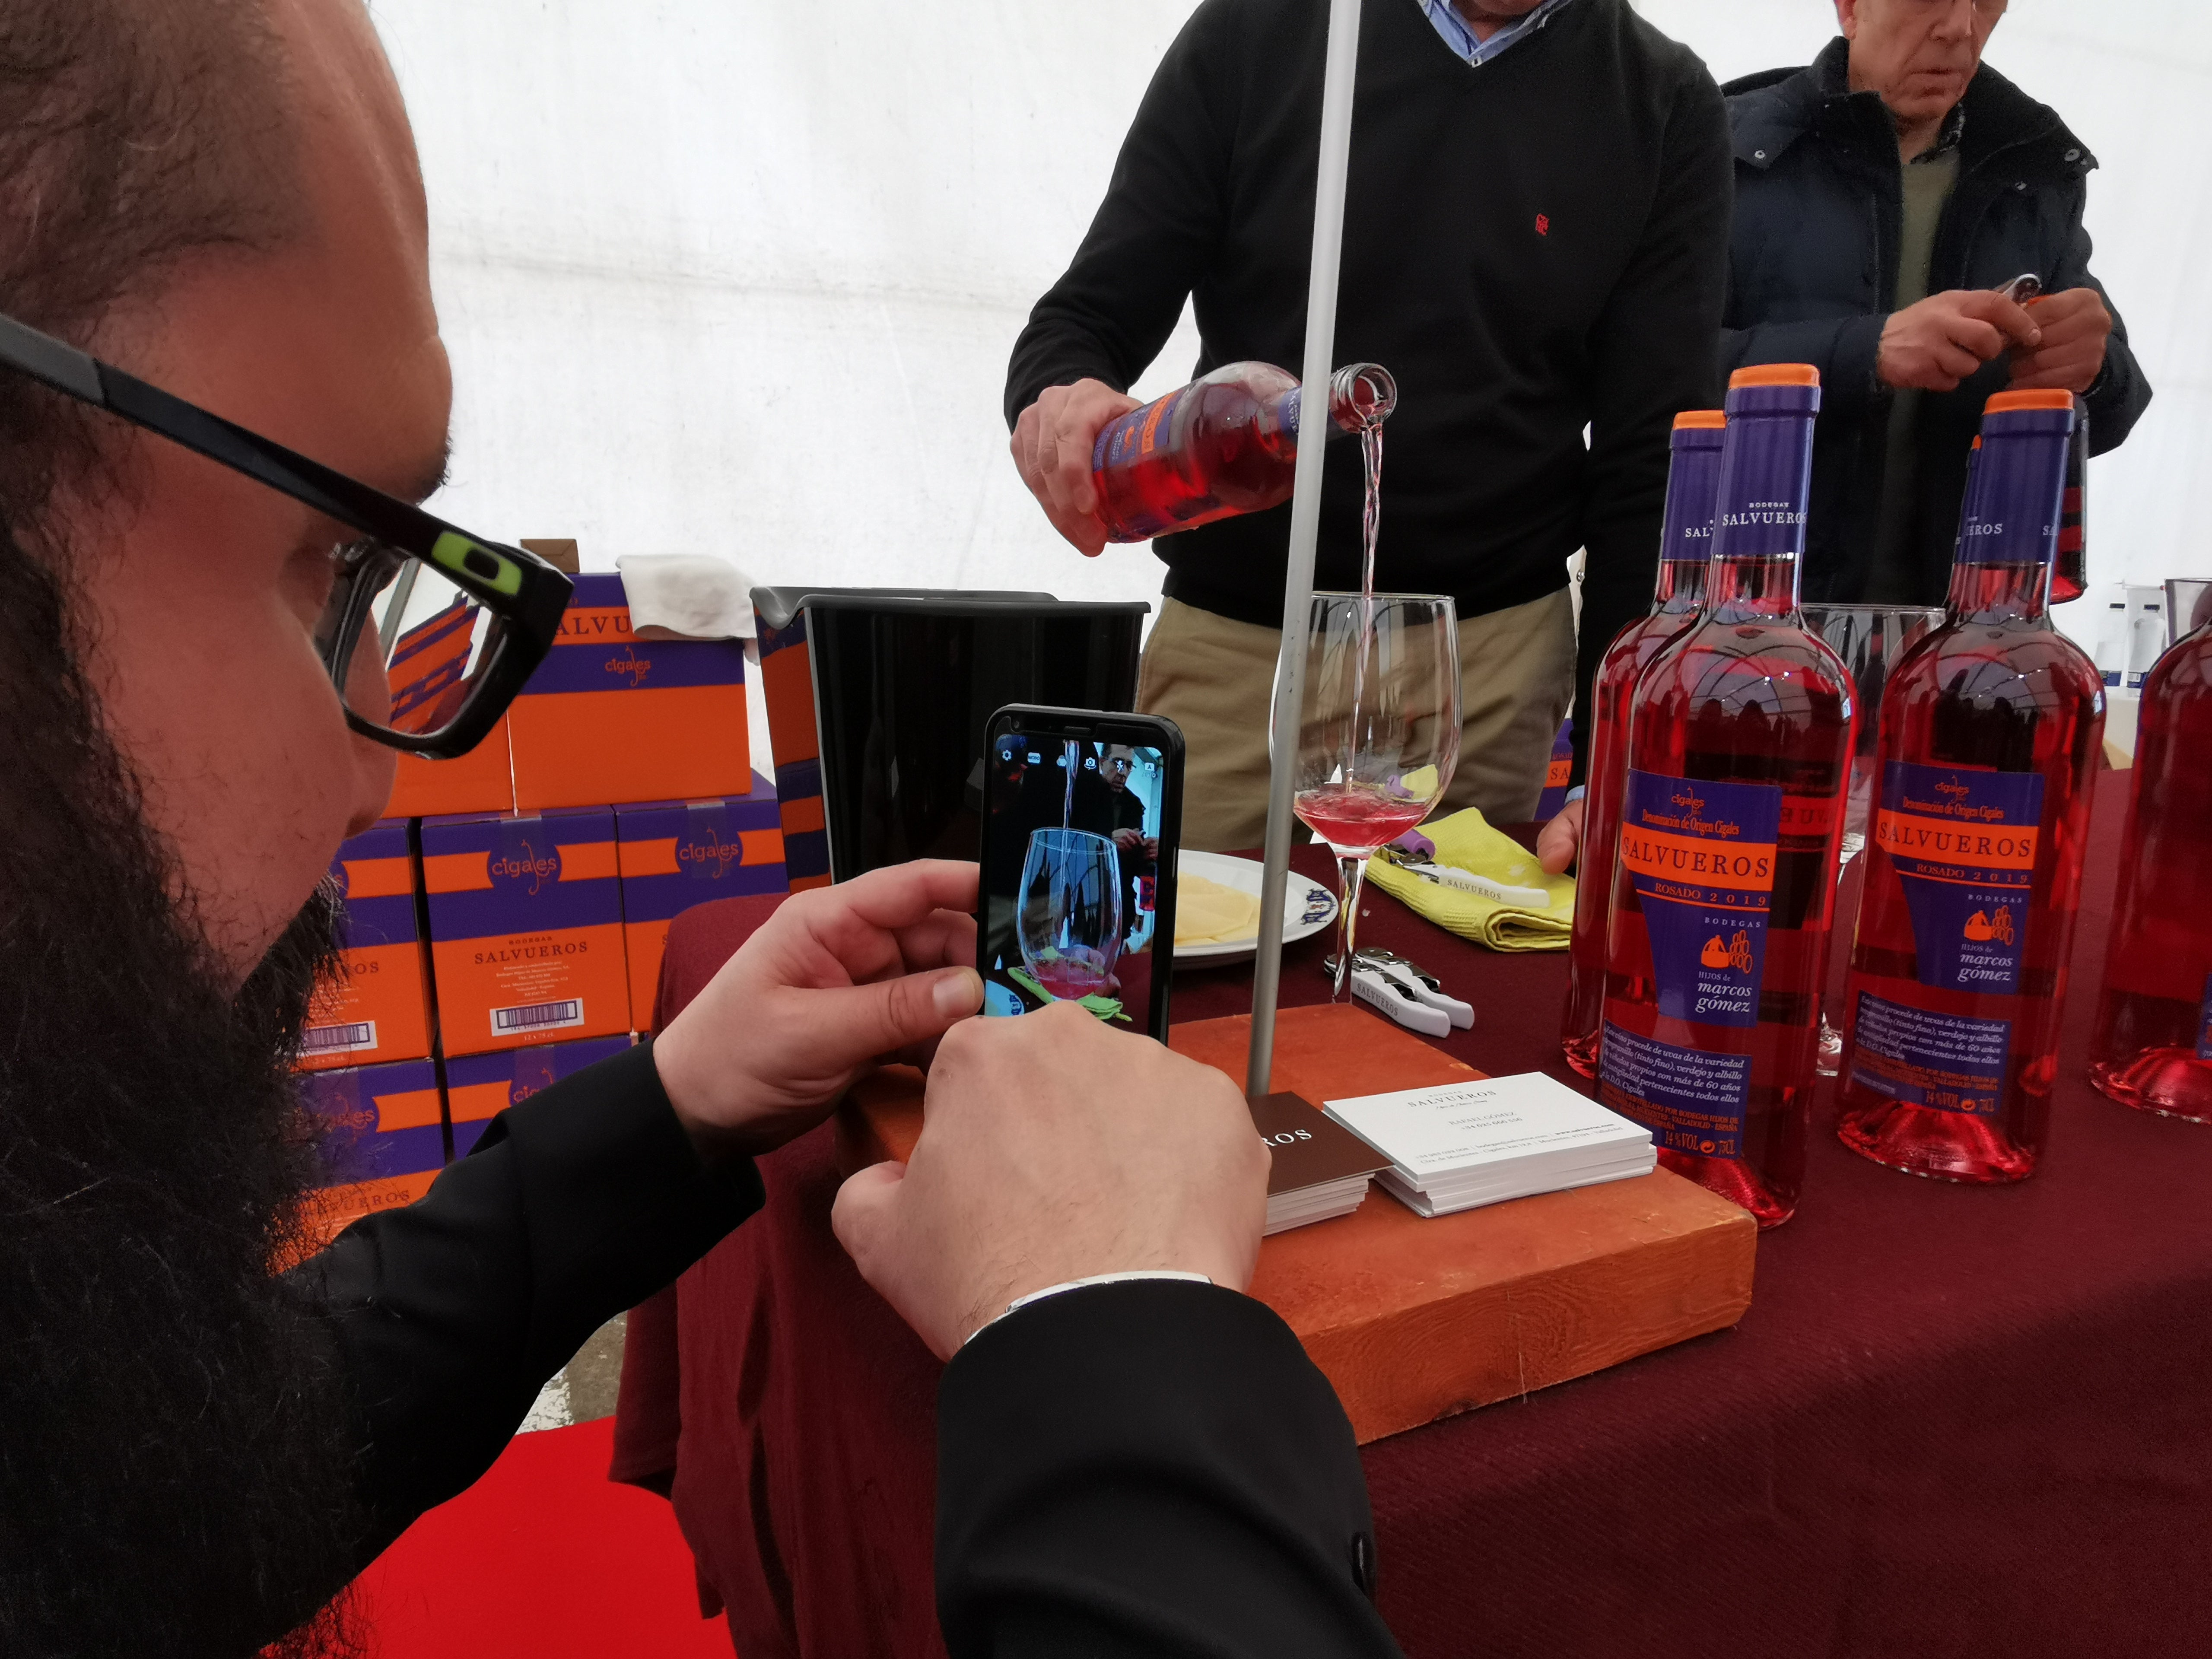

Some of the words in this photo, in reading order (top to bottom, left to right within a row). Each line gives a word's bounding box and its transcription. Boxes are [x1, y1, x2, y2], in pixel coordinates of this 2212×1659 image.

[1722, 512, 1808, 526] SALVUEROS
[1681, 816, 1689, 829] de
[1690, 817, 1713, 836] Origen
[1715, 820, 1740, 838] Cigales
[1879, 821, 2031, 858] SALVUEROS
[1623, 836, 1769, 879] SALVUEROS
[1916, 864, 1965, 878] ROSADO
[1447, 879, 1501, 900] SALVUEROS
[1655, 882, 1701, 900] ROSADO
[1968, 894, 2023, 903] BODEGAS
[1704, 916, 1761, 928] BODEGAS
[474, 941, 588, 964] SALVUEROS
[1959, 953, 2013, 967] marcos
[1698, 971, 1722, 982] HIJOS
[1723, 973, 1731, 982] de
[1957, 966, 2011, 982] gómez
[1697, 981, 1752, 998] marcos
[1357, 983, 1398, 1017] SALVUEROS
[1694, 994, 1750, 1014] gómez
[1627, 1038, 1652, 1052] procede
[1653, 1046, 1662, 1055] de
[1663, 1052, 1682, 1061] uvas
[1683, 1053, 1694, 1062] de
[1694, 1055, 1704, 1064] la
[1705, 1058, 1745, 1068] variedad
[1630, 1061, 1656, 1077] propios
[1657, 1072, 1672, 1081] con
[1673, 1075, 1691, 1086] más
[1693, 1079, 1704, 1088] de
[1706, 1081, 1719, 1090] 60
[1720, 1081, 1741, 1091] años
[1676, 1065, 1707, 1077] verdejo
[1707, 1071, 1714, 1079] y
[1715, 1070, 1742, 1080] albillo
[1622, 1081, 1645, 1097] Cigales
[1640, 1078, 1695, 1097] pertenecientes
[1696, 1091, 1719, 1101] todos
[1720, 1093, 1740, 1103] ellos
[1408, 1090, 1496, 1107] SALVUEROS
